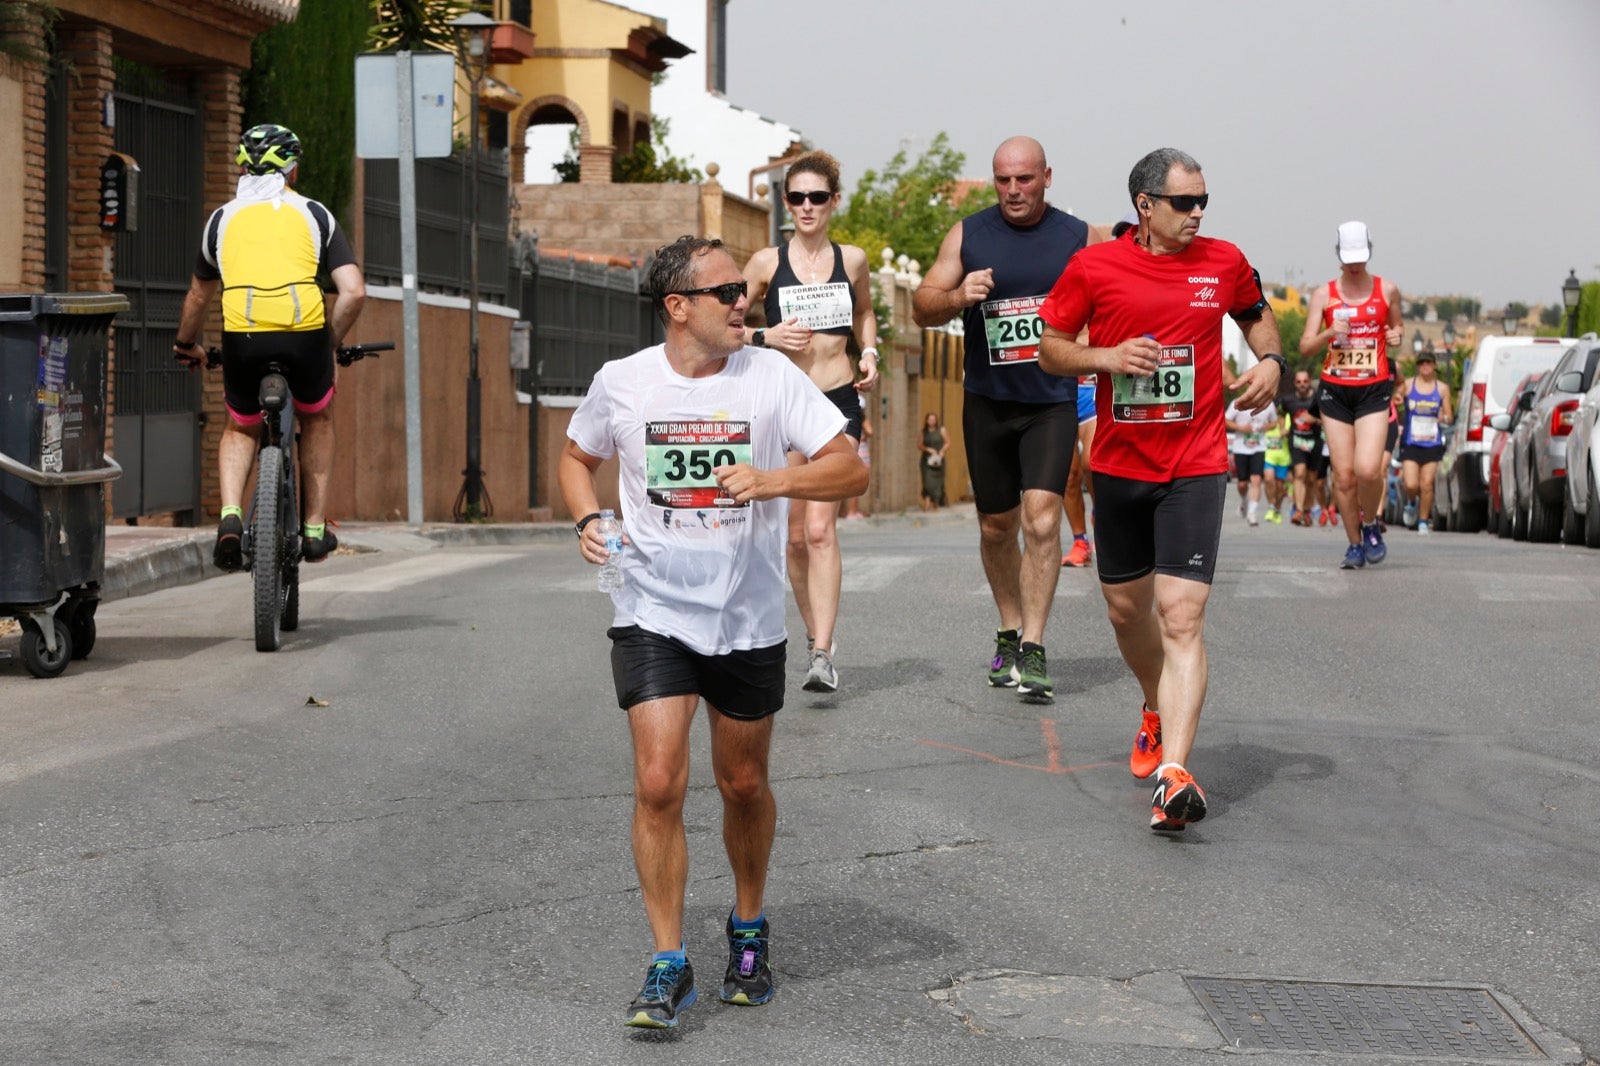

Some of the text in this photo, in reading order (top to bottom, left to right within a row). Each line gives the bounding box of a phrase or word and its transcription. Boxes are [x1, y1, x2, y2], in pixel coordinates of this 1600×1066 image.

[1188, 277, 1219, 285] COCINAS
[792, 286, 817, 294] CORRO
[998, 316, 1045, 343] 260
[1163, 348, 1188, 358] DE FONDO
[1337, 352, 1371, 365] 2121
[1126, 370, 1181, 398] 48
[669, 423, 687, 434] GRAN
[688, 423, 712, 434] PREMIO
[714, 423, 723, 434] DE
[724, 423, 745, 434] FONDO
[663, 449, 736, 481] 350
[720, 516, 746, 526] agroisa
